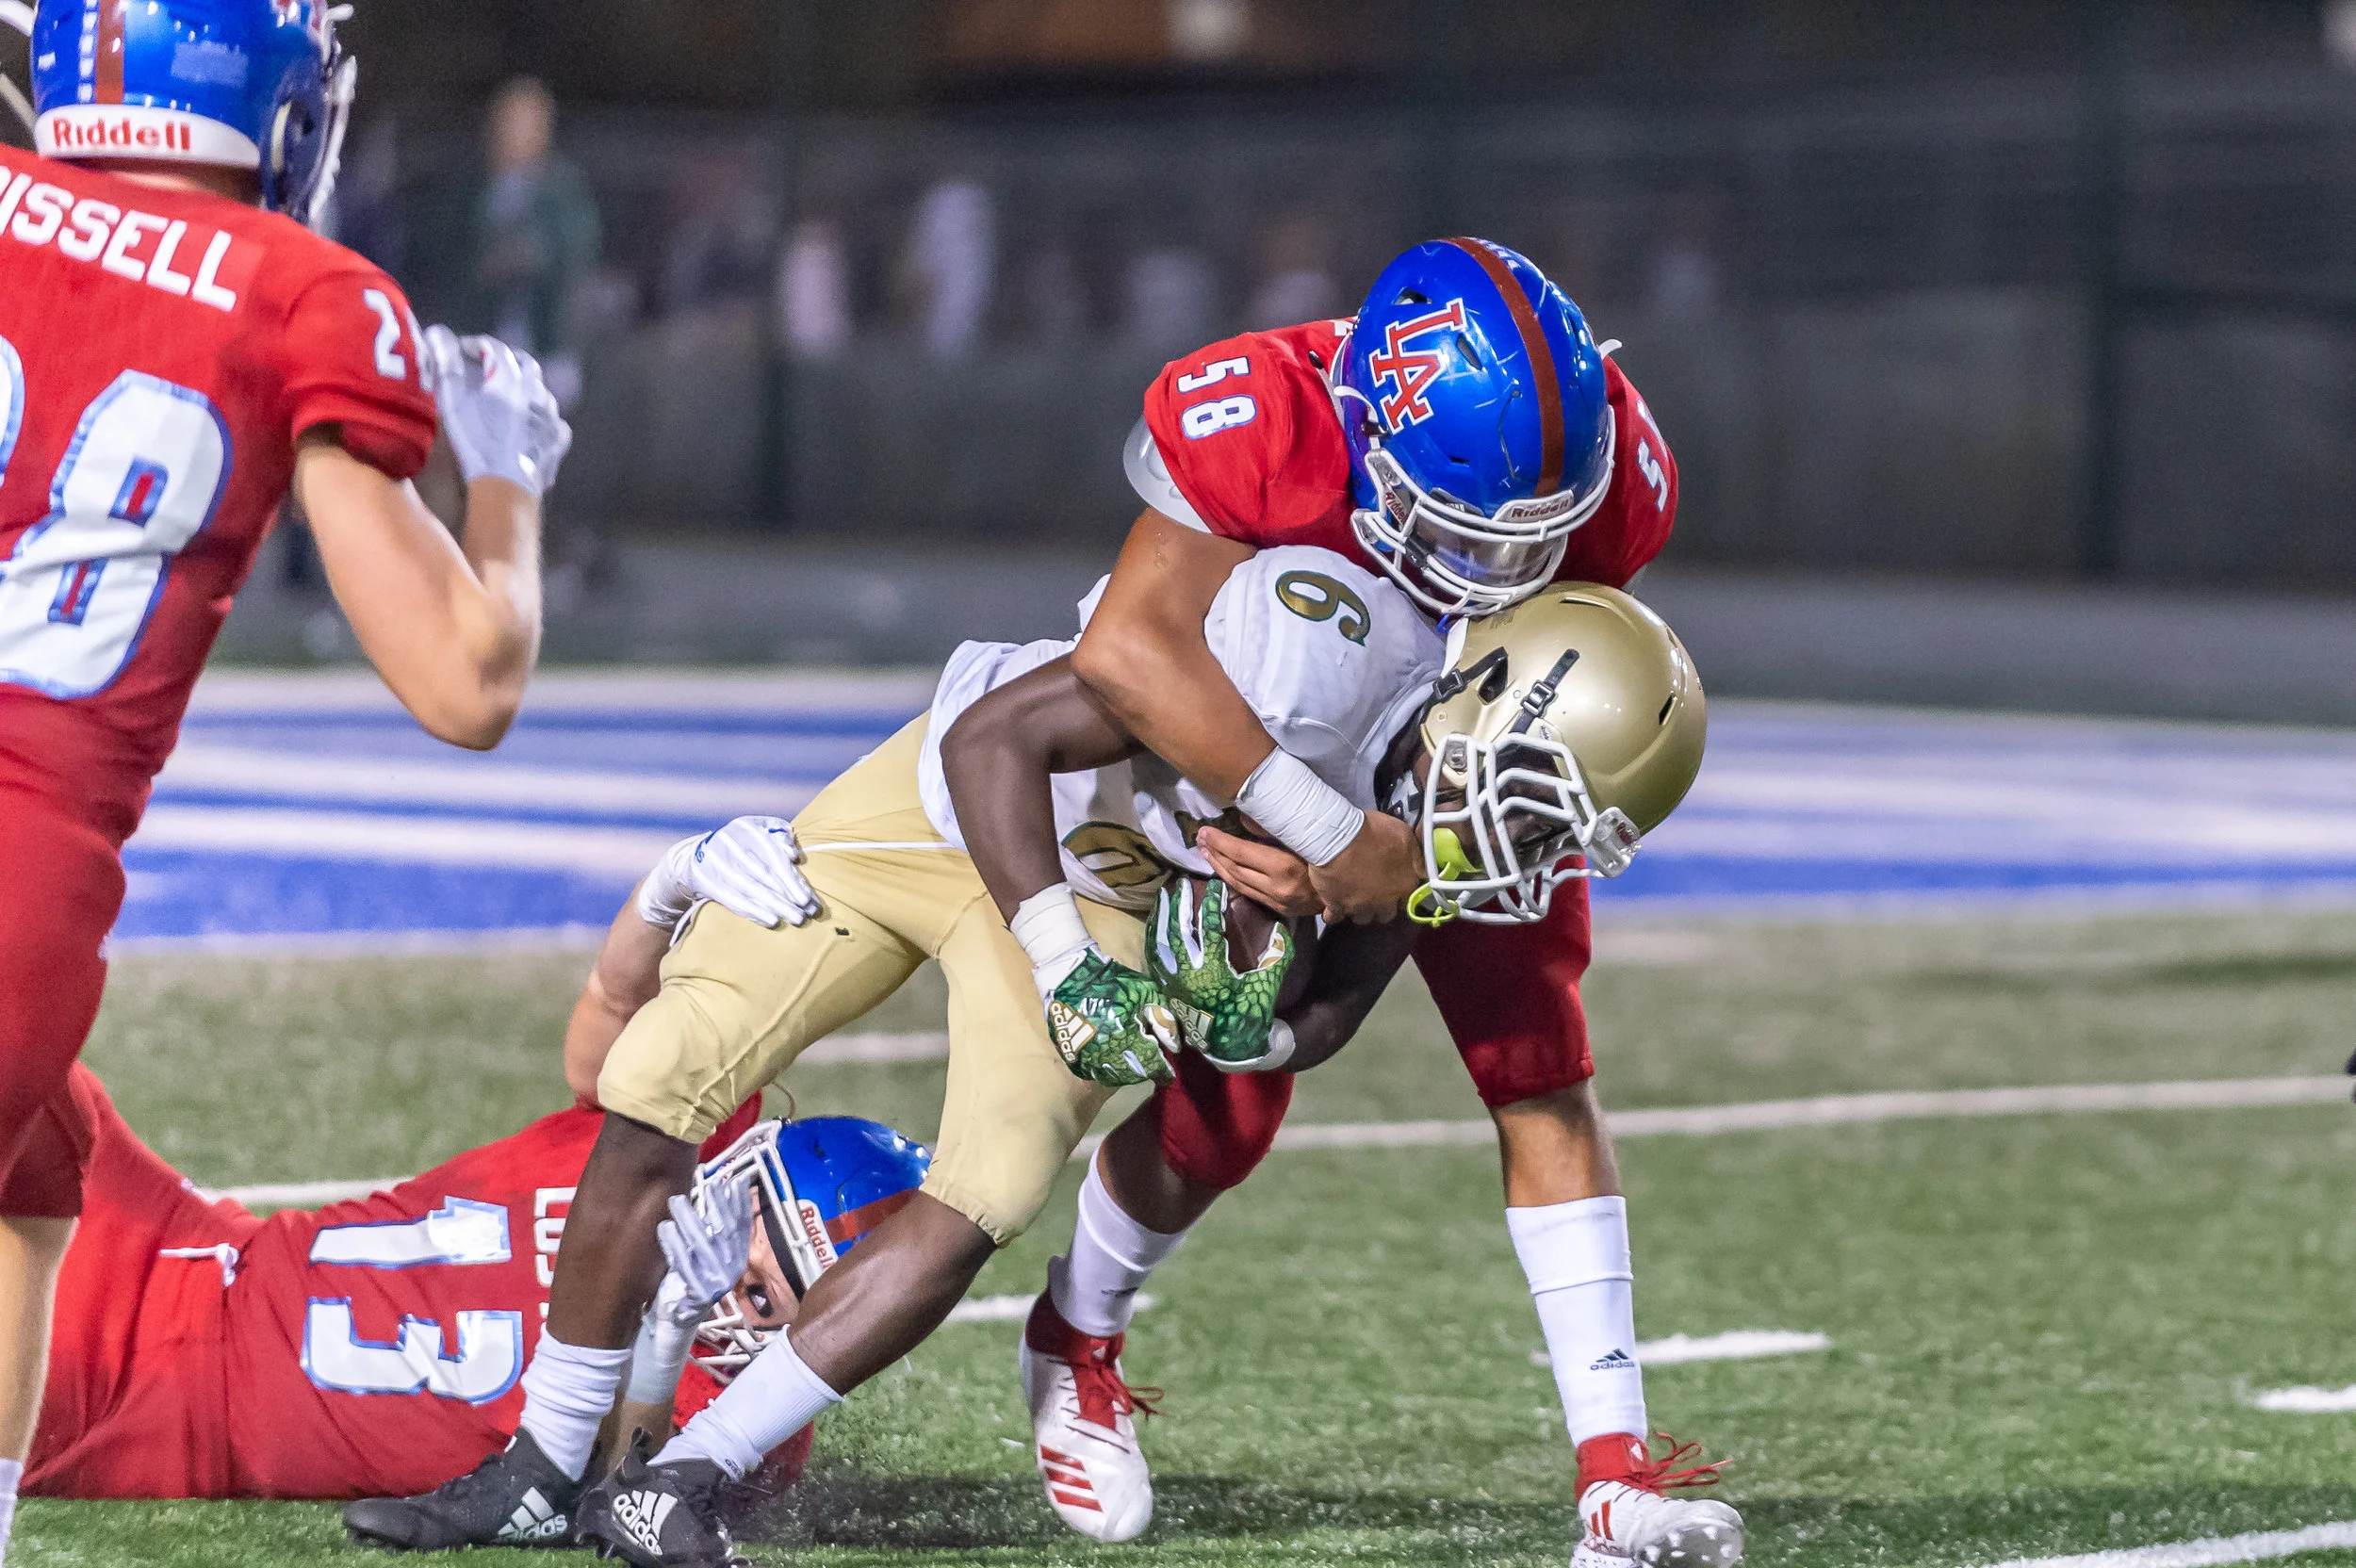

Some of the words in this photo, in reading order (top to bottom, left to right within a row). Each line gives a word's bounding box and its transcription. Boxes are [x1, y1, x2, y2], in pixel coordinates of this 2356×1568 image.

[52, 116, 191, 152] Riddell
[0, 164, 237, 313] ISSELL
[1176, 355, 1258, 440] 58
[1368, 297, 1468, 435] LA
[1511, 498, 1571, 518] Riddell
[1050, 1001, 1076, 1062] adidas
[800, 1205, 836, 1269] Riddell
[299, 1195, 524, 1406] 13
[1589, 1360, 1636, 1371] adidas
